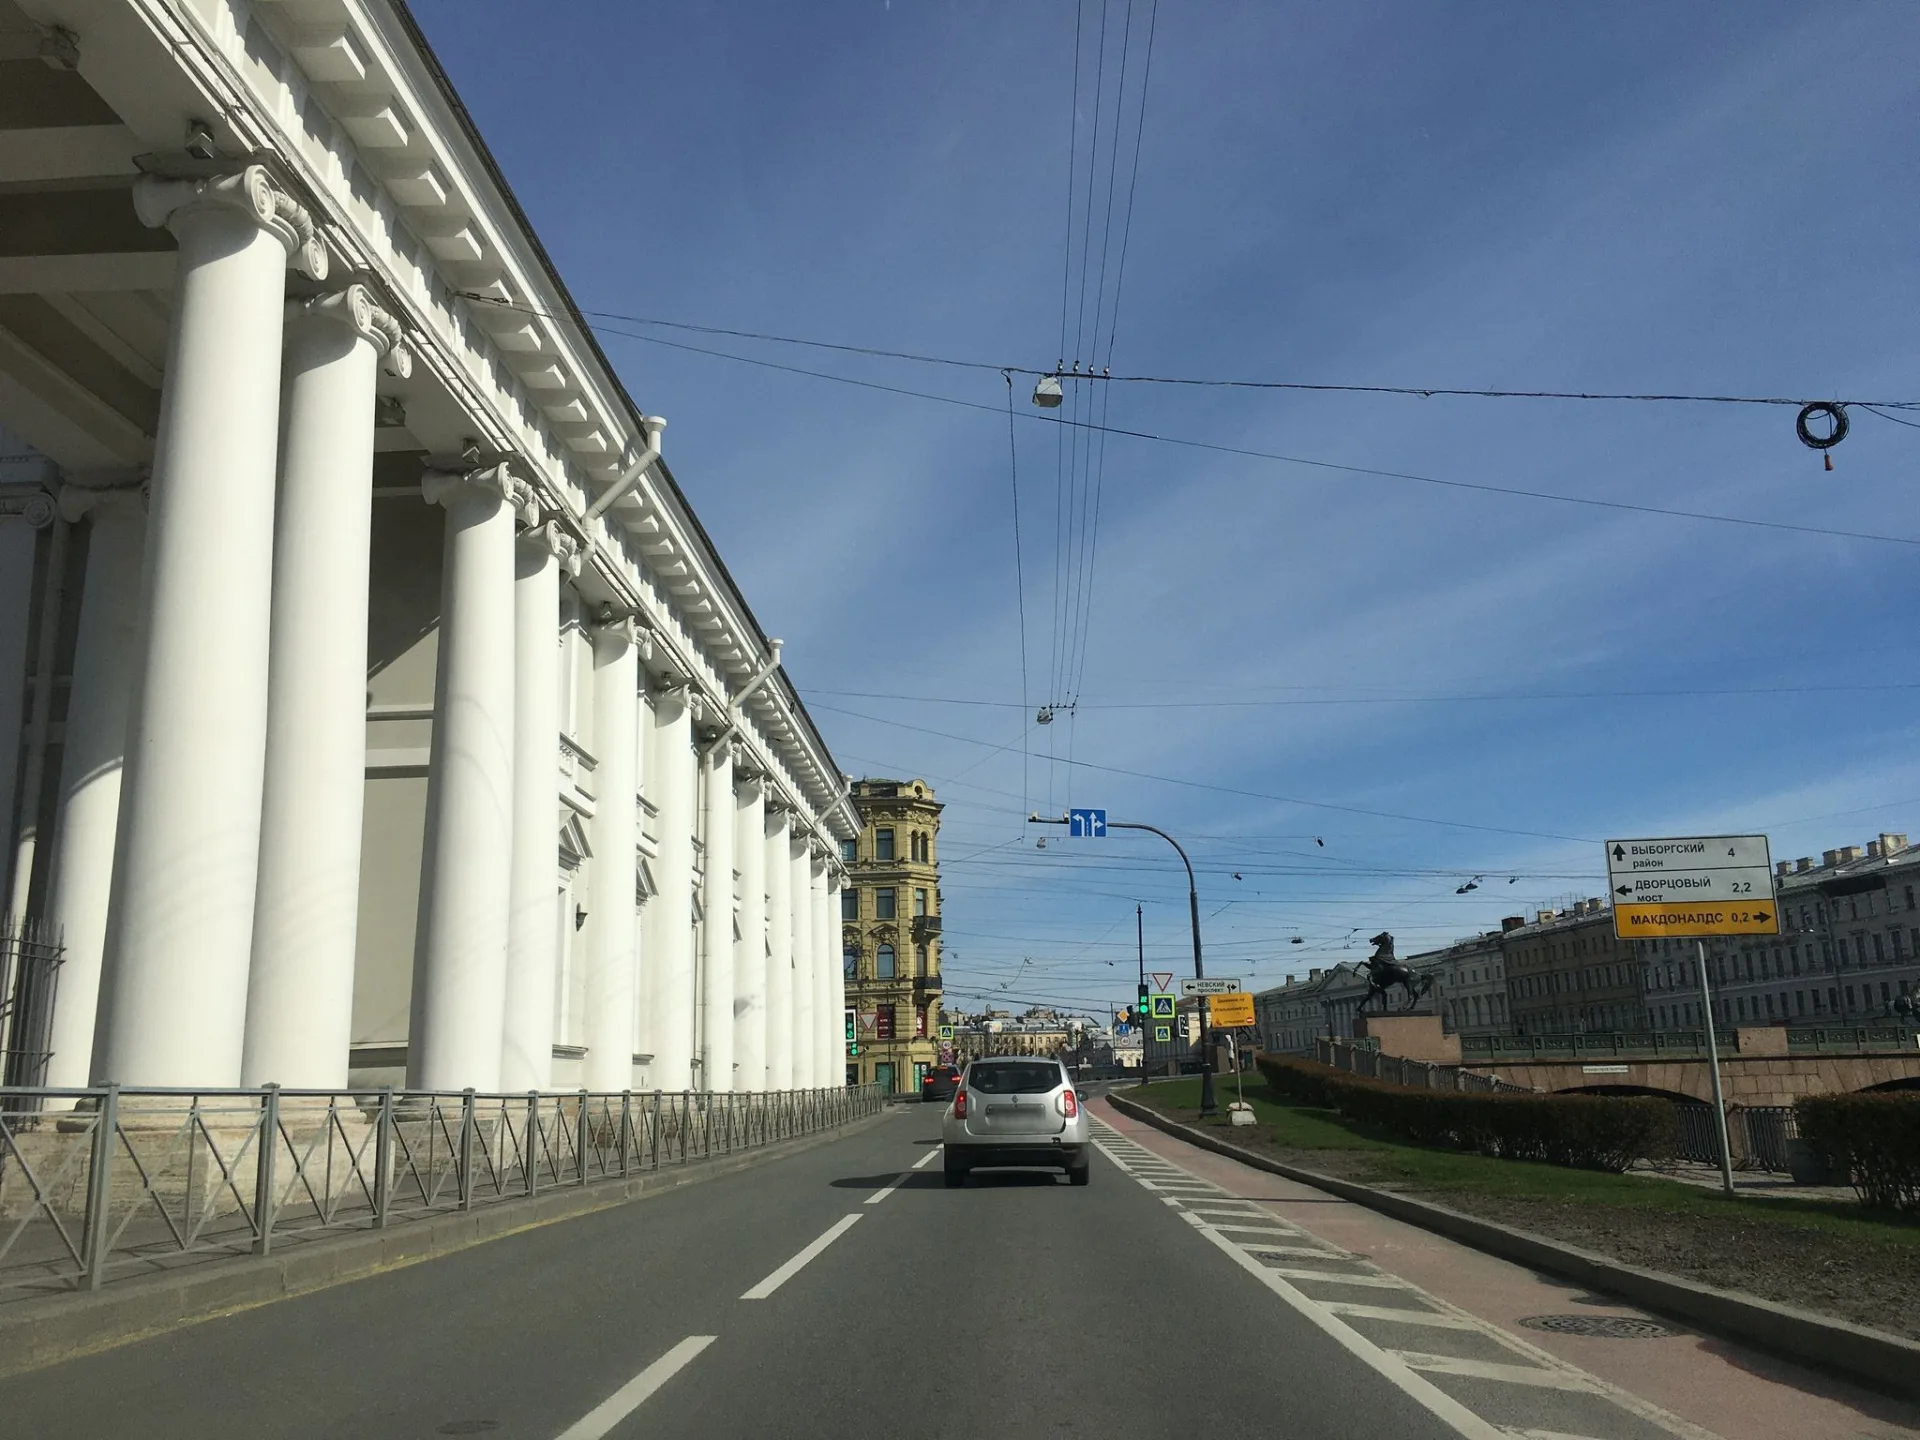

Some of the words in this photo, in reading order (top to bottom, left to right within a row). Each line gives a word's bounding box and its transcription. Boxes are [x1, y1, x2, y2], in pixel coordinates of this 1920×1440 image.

[1631, 843, 1705, 855] ВЫБОРГСКИЙ
[1727, 848, 1735, 857] 4
[1632, 859, 1664, 869] район
[1635, 876, 1711, 890] ДВОРЦОВЫЙ
[1732, 882, 1752, 893] 2,2
[1637, 894, 1663, 902] мост
[1630, 912, 1724, 926] МАКДОНАЛДС
[1731, 912, 1749, 924] 0,2
